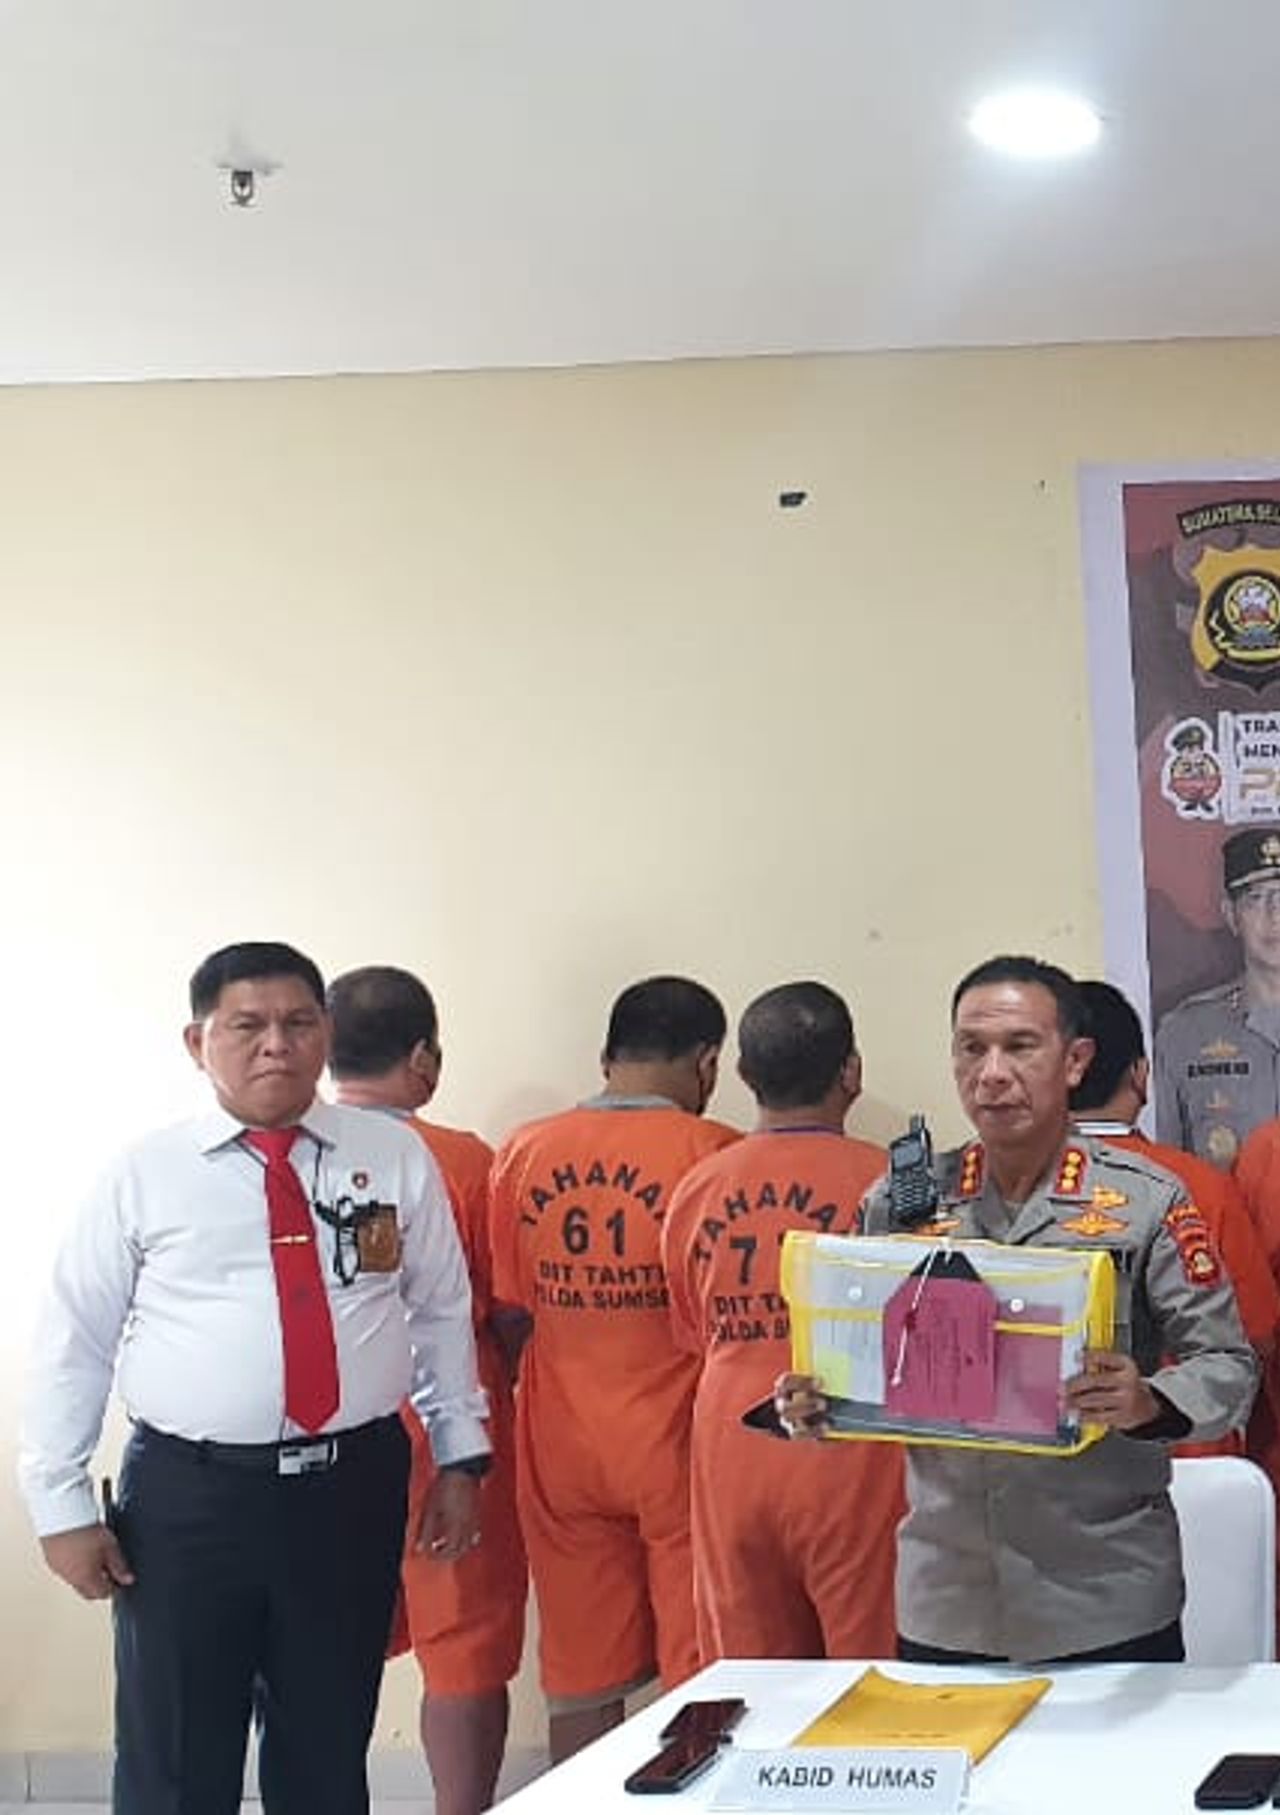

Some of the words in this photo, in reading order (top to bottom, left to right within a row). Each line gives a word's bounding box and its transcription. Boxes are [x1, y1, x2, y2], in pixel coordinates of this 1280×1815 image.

[562, 1204, 626, 1258] 61
[728, 1229, 785, 1287] 7
[539, 1260, 575, 1283] DIT
[713, 1295, 754, 1317] DIT
[756, 1765, 835, 1789] KABID
[848, 1766, 938, 1790] HUMAS
